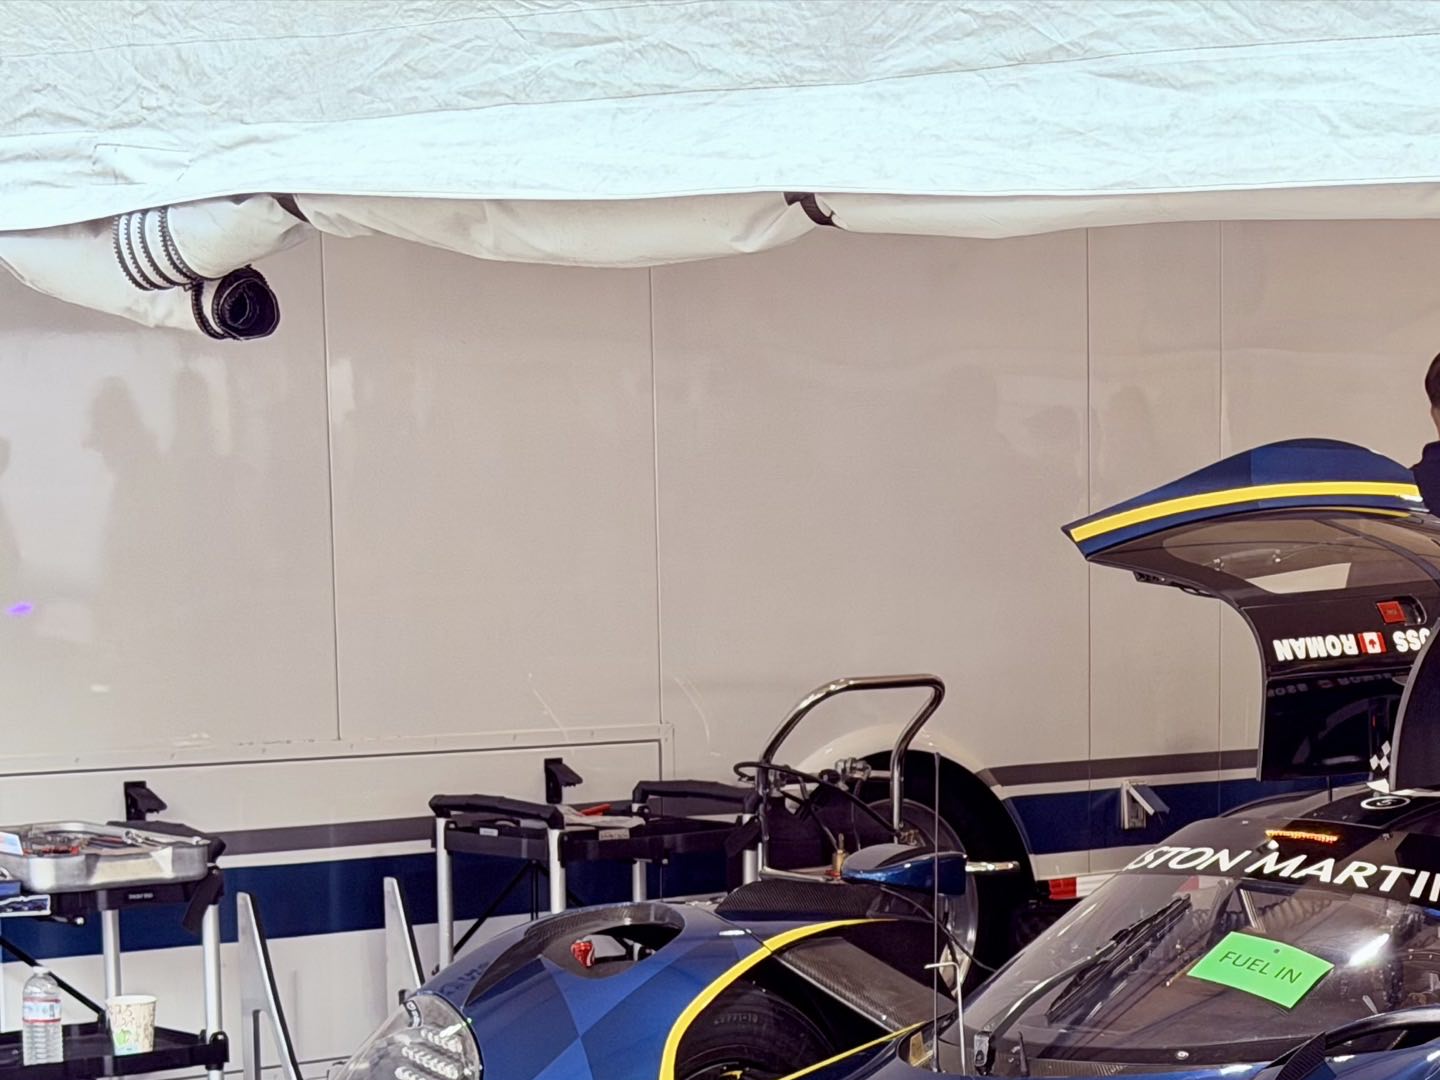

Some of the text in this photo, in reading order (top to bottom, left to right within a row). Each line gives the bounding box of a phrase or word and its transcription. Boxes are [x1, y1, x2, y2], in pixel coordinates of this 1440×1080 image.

[1272, 633, 1359, 662] ROMAN
[1219, 951, 1303, 985] FUEL IN
